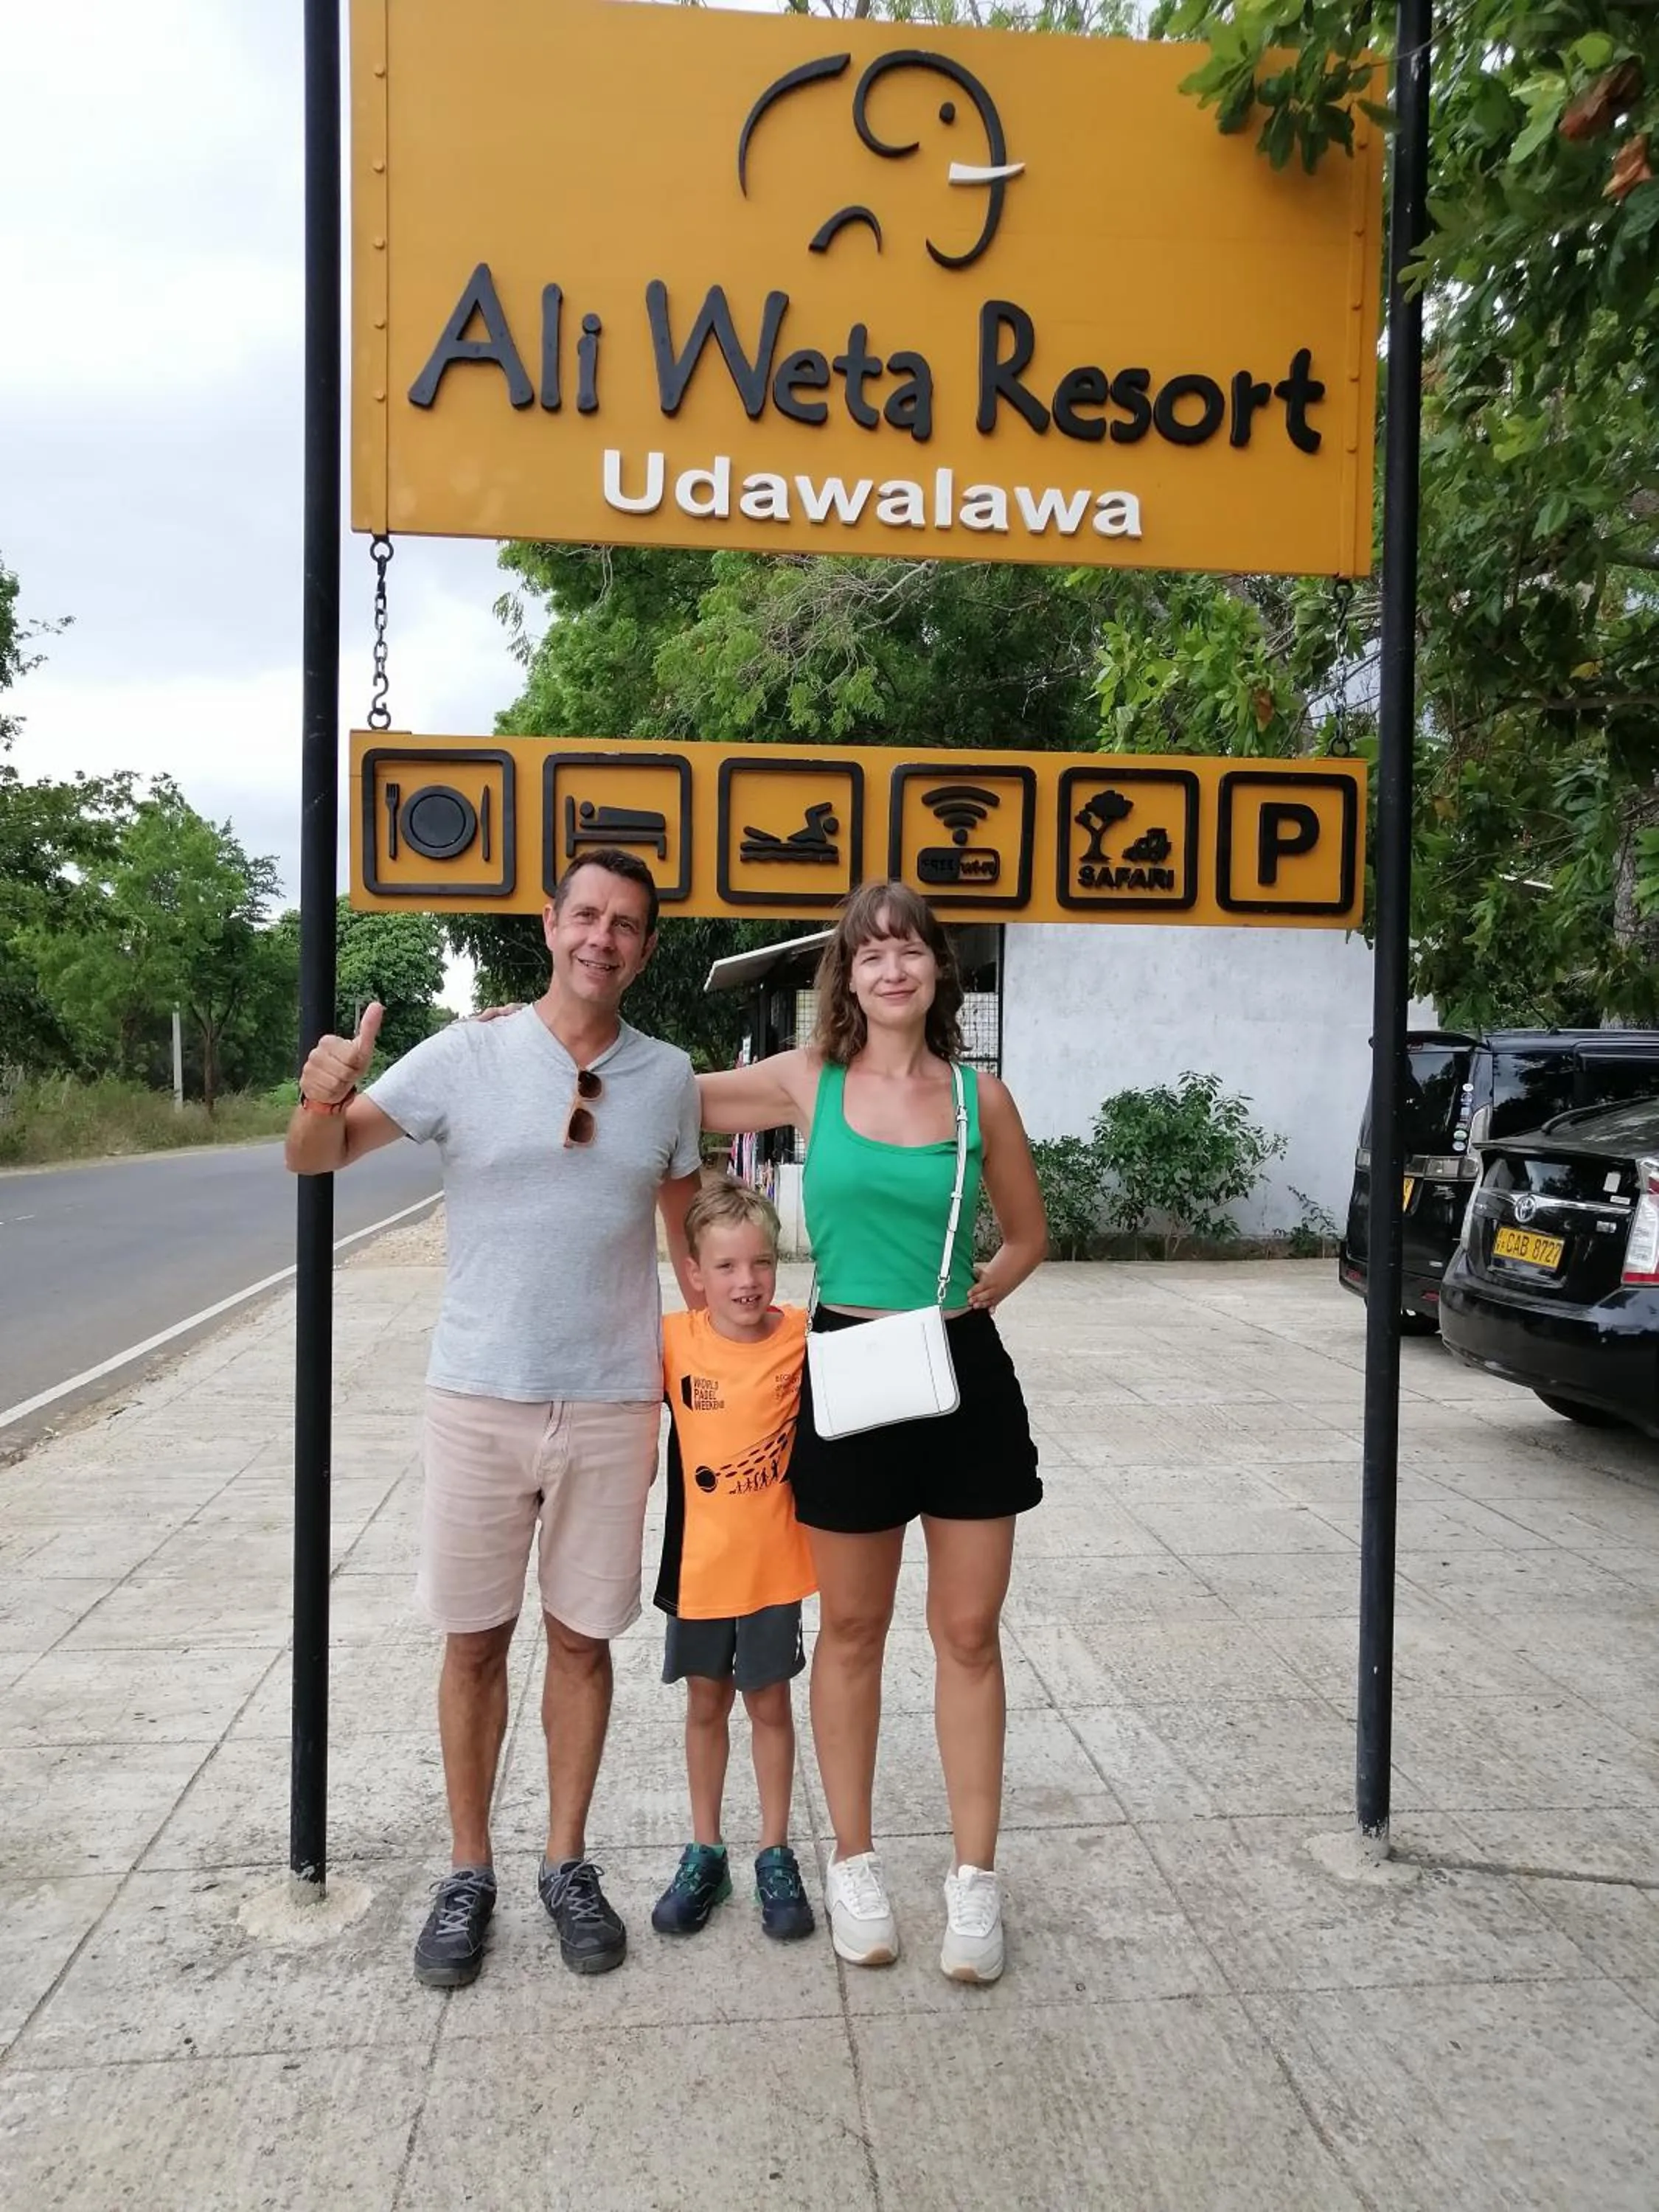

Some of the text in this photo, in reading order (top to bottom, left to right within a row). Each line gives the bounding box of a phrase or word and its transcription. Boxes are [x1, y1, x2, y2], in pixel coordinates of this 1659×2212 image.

[408, 262, 1326, 455] Ali Weta Resort
[601, 448, 1143, 538] Udawalawa
[1077, 865, 1175, 891] SAFARI
[1257, 801, 1321, 888] P
[1506, 1232, 1530, 1257] CAB
[1532, 1238, 1562, 1264] 8727
